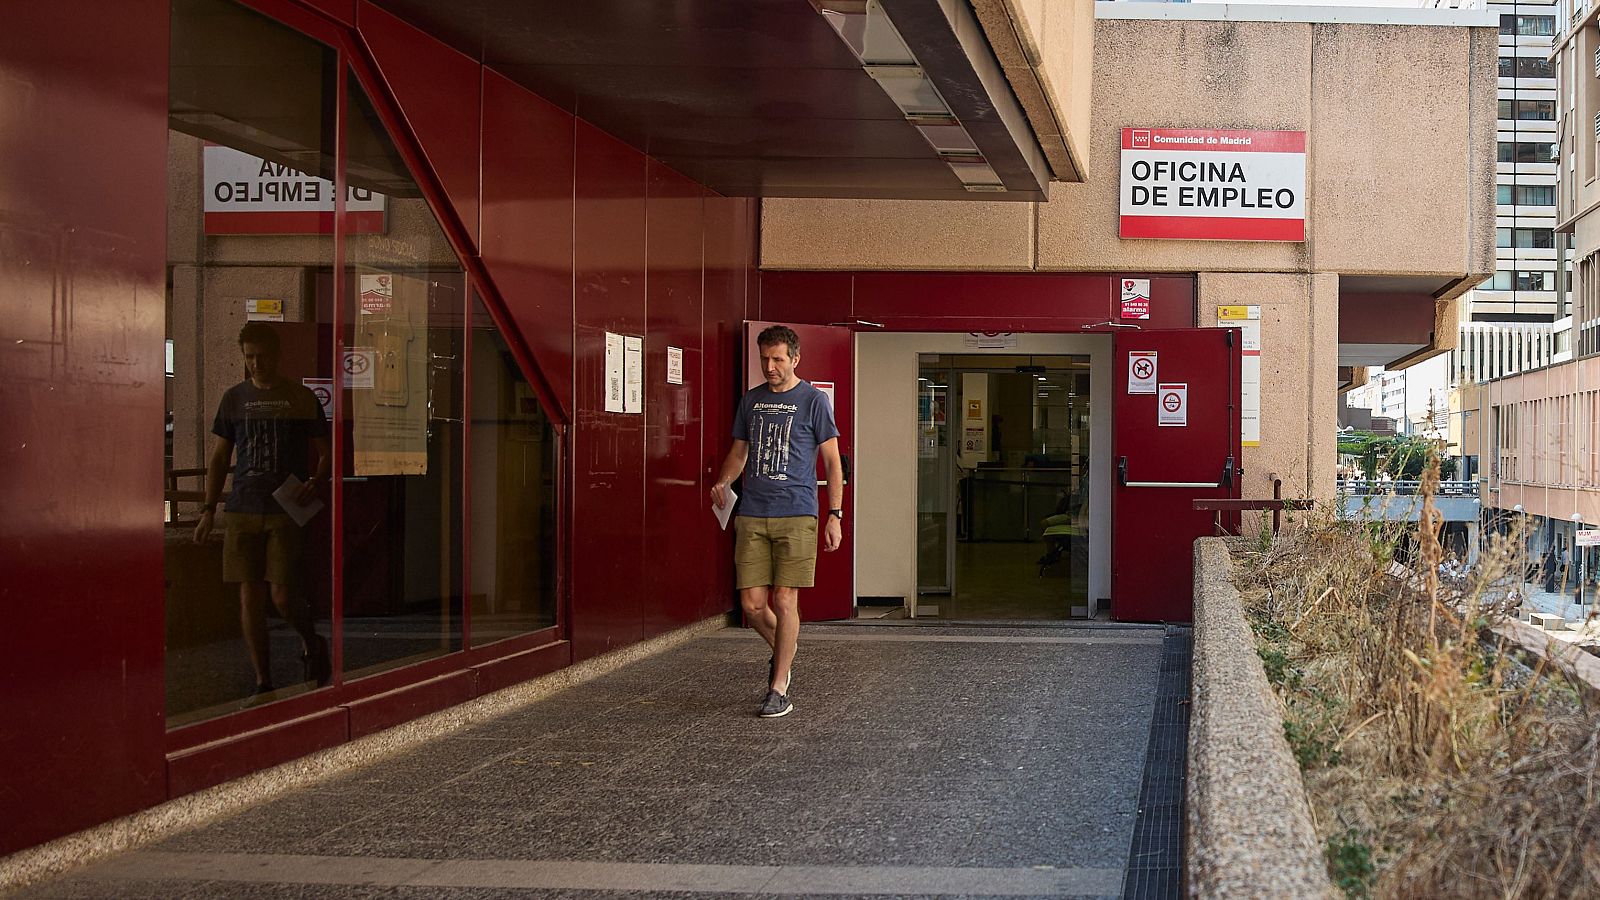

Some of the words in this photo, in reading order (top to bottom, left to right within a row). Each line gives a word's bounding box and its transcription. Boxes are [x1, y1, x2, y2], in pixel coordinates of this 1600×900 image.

[1153, 135, 1204, 145] Comunidad
[1206, 136, 1218, 145] de
[1220, 136, 1252, 145] Madrid
[1131, 160, 1247, 183] OFICINA
[1131, 185, 1168, 207] DE
[1178, 186, 1295, 209] EMPLEO
[753, 402, 798, 411] Altonadock
